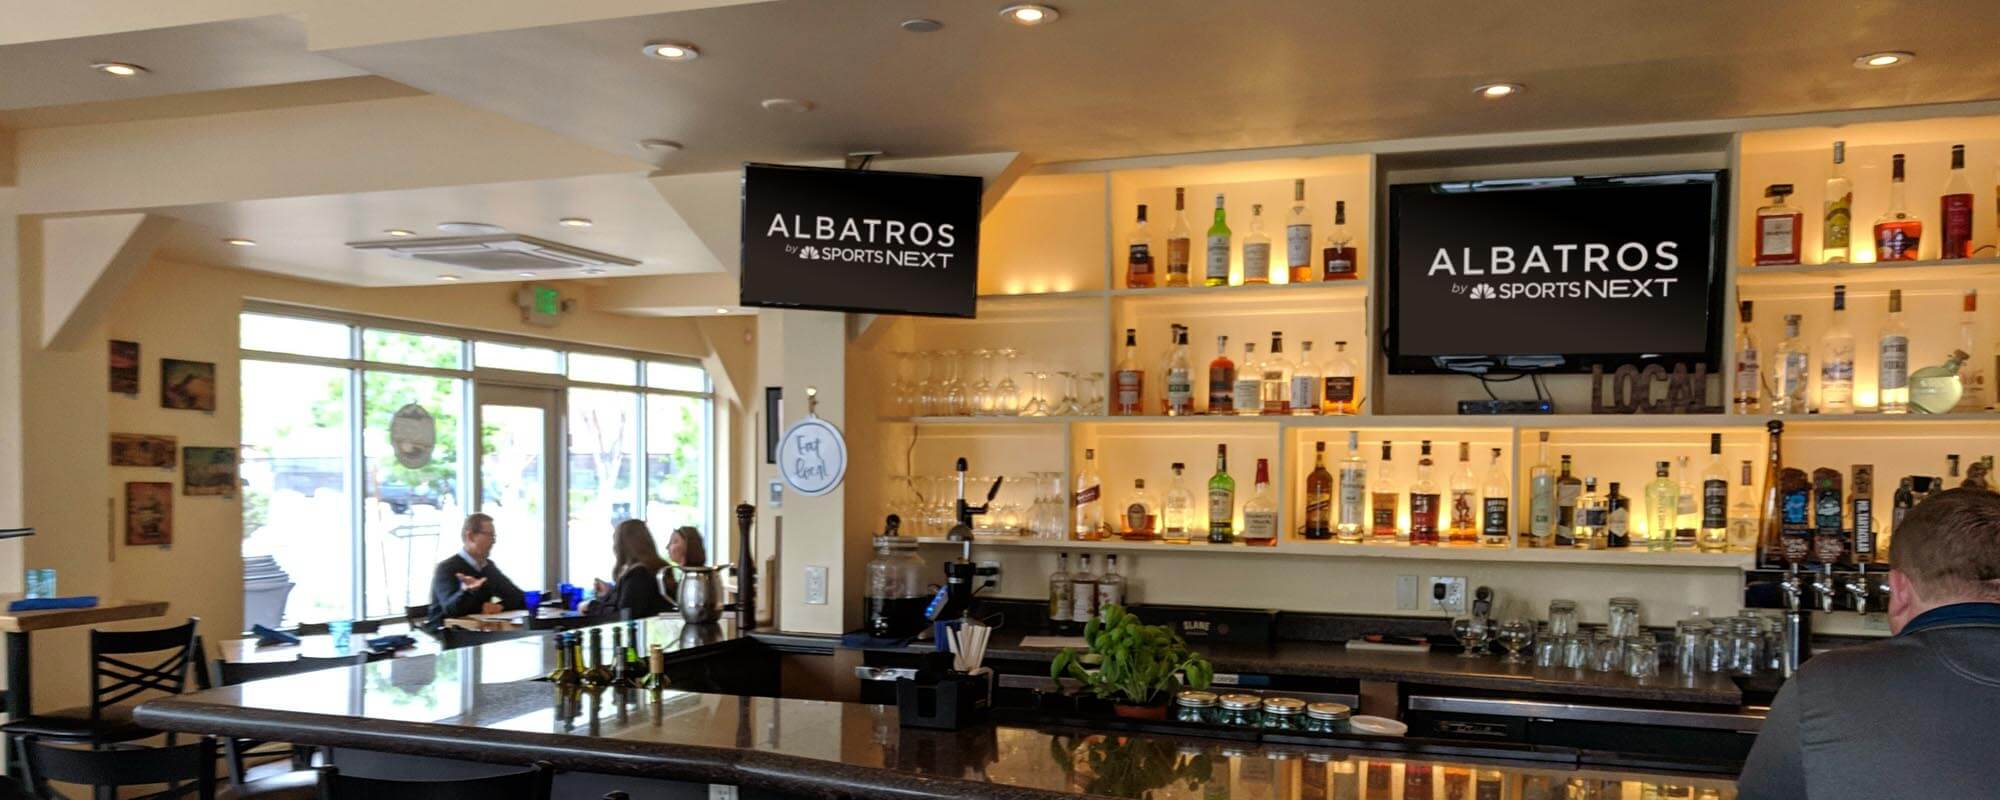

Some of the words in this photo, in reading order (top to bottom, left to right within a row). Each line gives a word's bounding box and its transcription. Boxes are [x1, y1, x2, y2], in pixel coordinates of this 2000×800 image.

[767, 213, 955, 247] ALBATROS
[785, 244, 798, 255] by
[822, 247, 884, 264] SPORTS
[885, 250, 954, 269] NEXT
[1428, 241, 1679, 276] ALBATROS
[1451, 283, 1468, 295] by
[1499, 282, 1581, 299] SPORTS
[1585, 278, 1678, 299] NEXT
[1592, 362, 1725, 414] LOCAL
[796, 434, 821, 457] Eat
